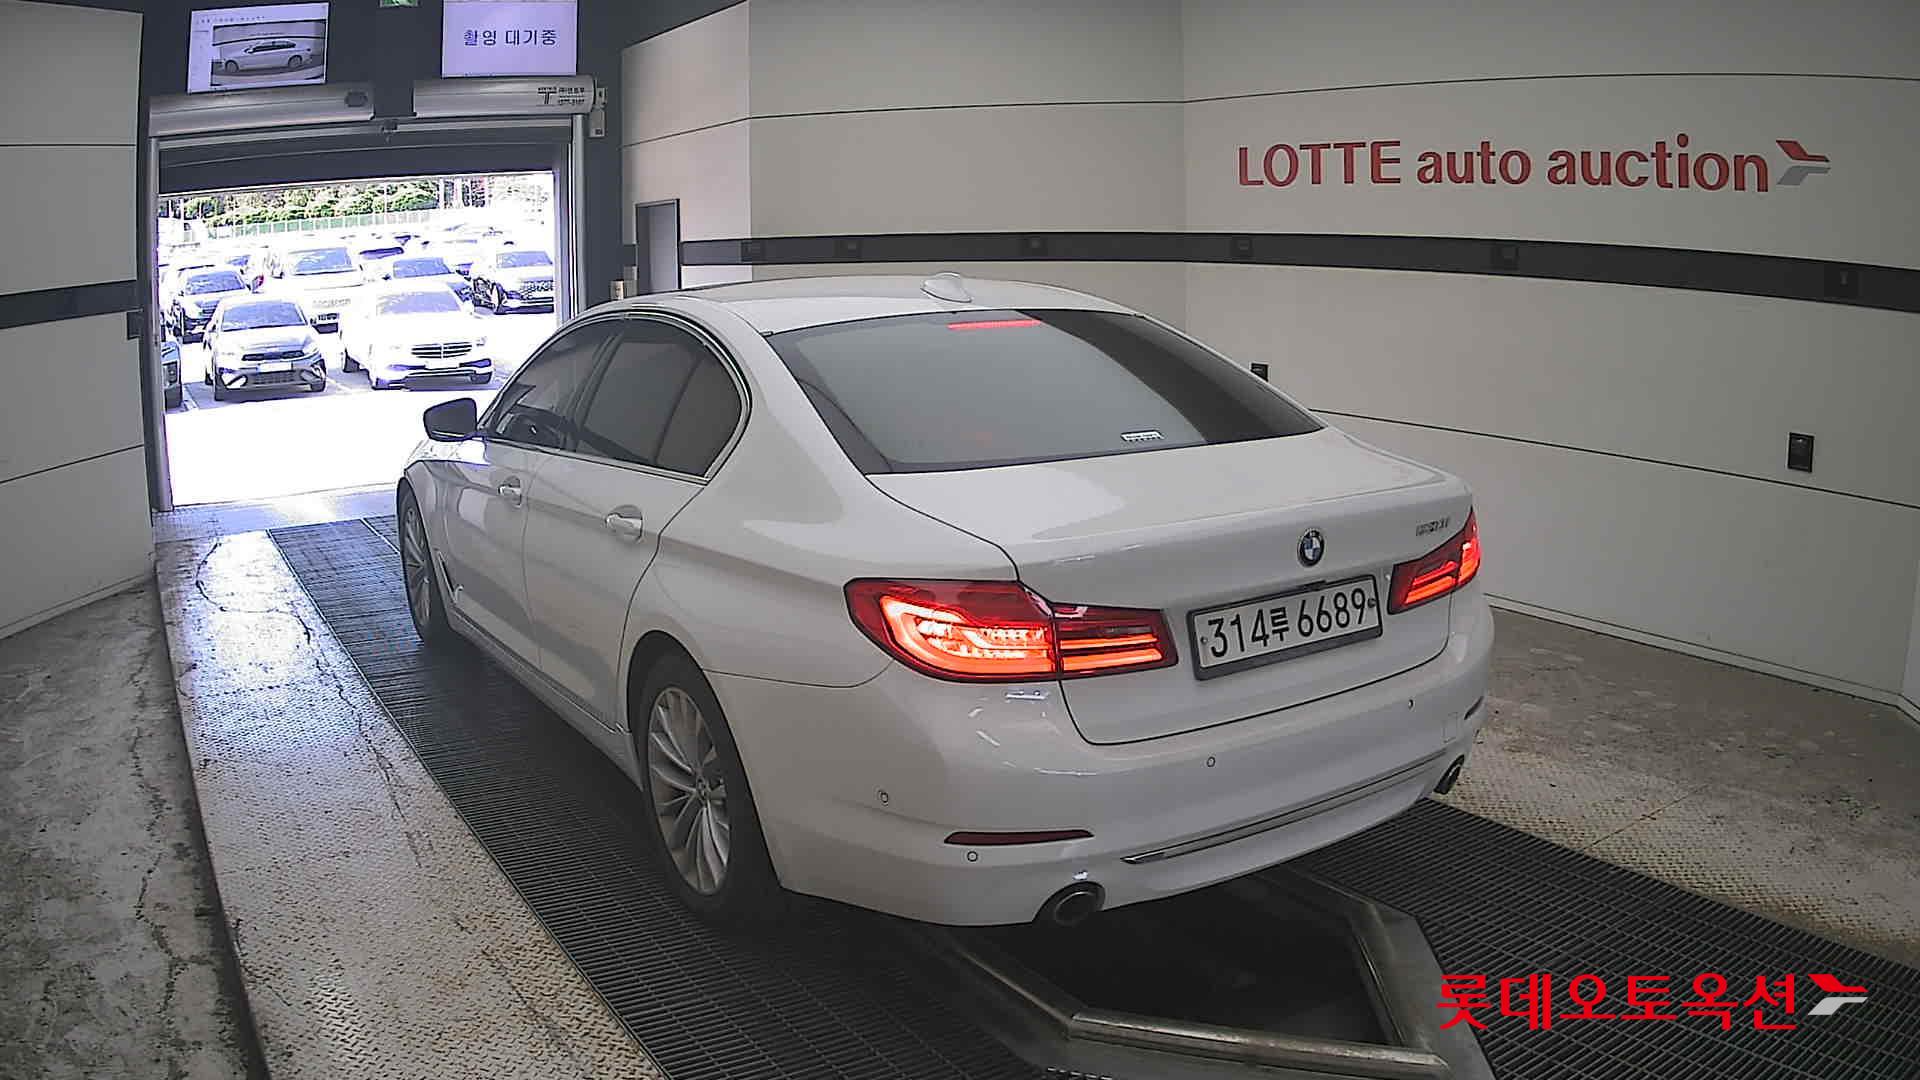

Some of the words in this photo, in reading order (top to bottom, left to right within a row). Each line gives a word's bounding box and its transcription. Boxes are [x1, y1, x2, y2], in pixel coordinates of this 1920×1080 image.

[505, 29, 557, 46] 대기중
[1238, 140, 1400, 186] LOTTE
[1416, 141, 1531, 184] auto
[1547, 133, 1769, 192] auction
[1208, 607, 1289, 657] 314루
[1297, 588, 1366, 637] 6689
